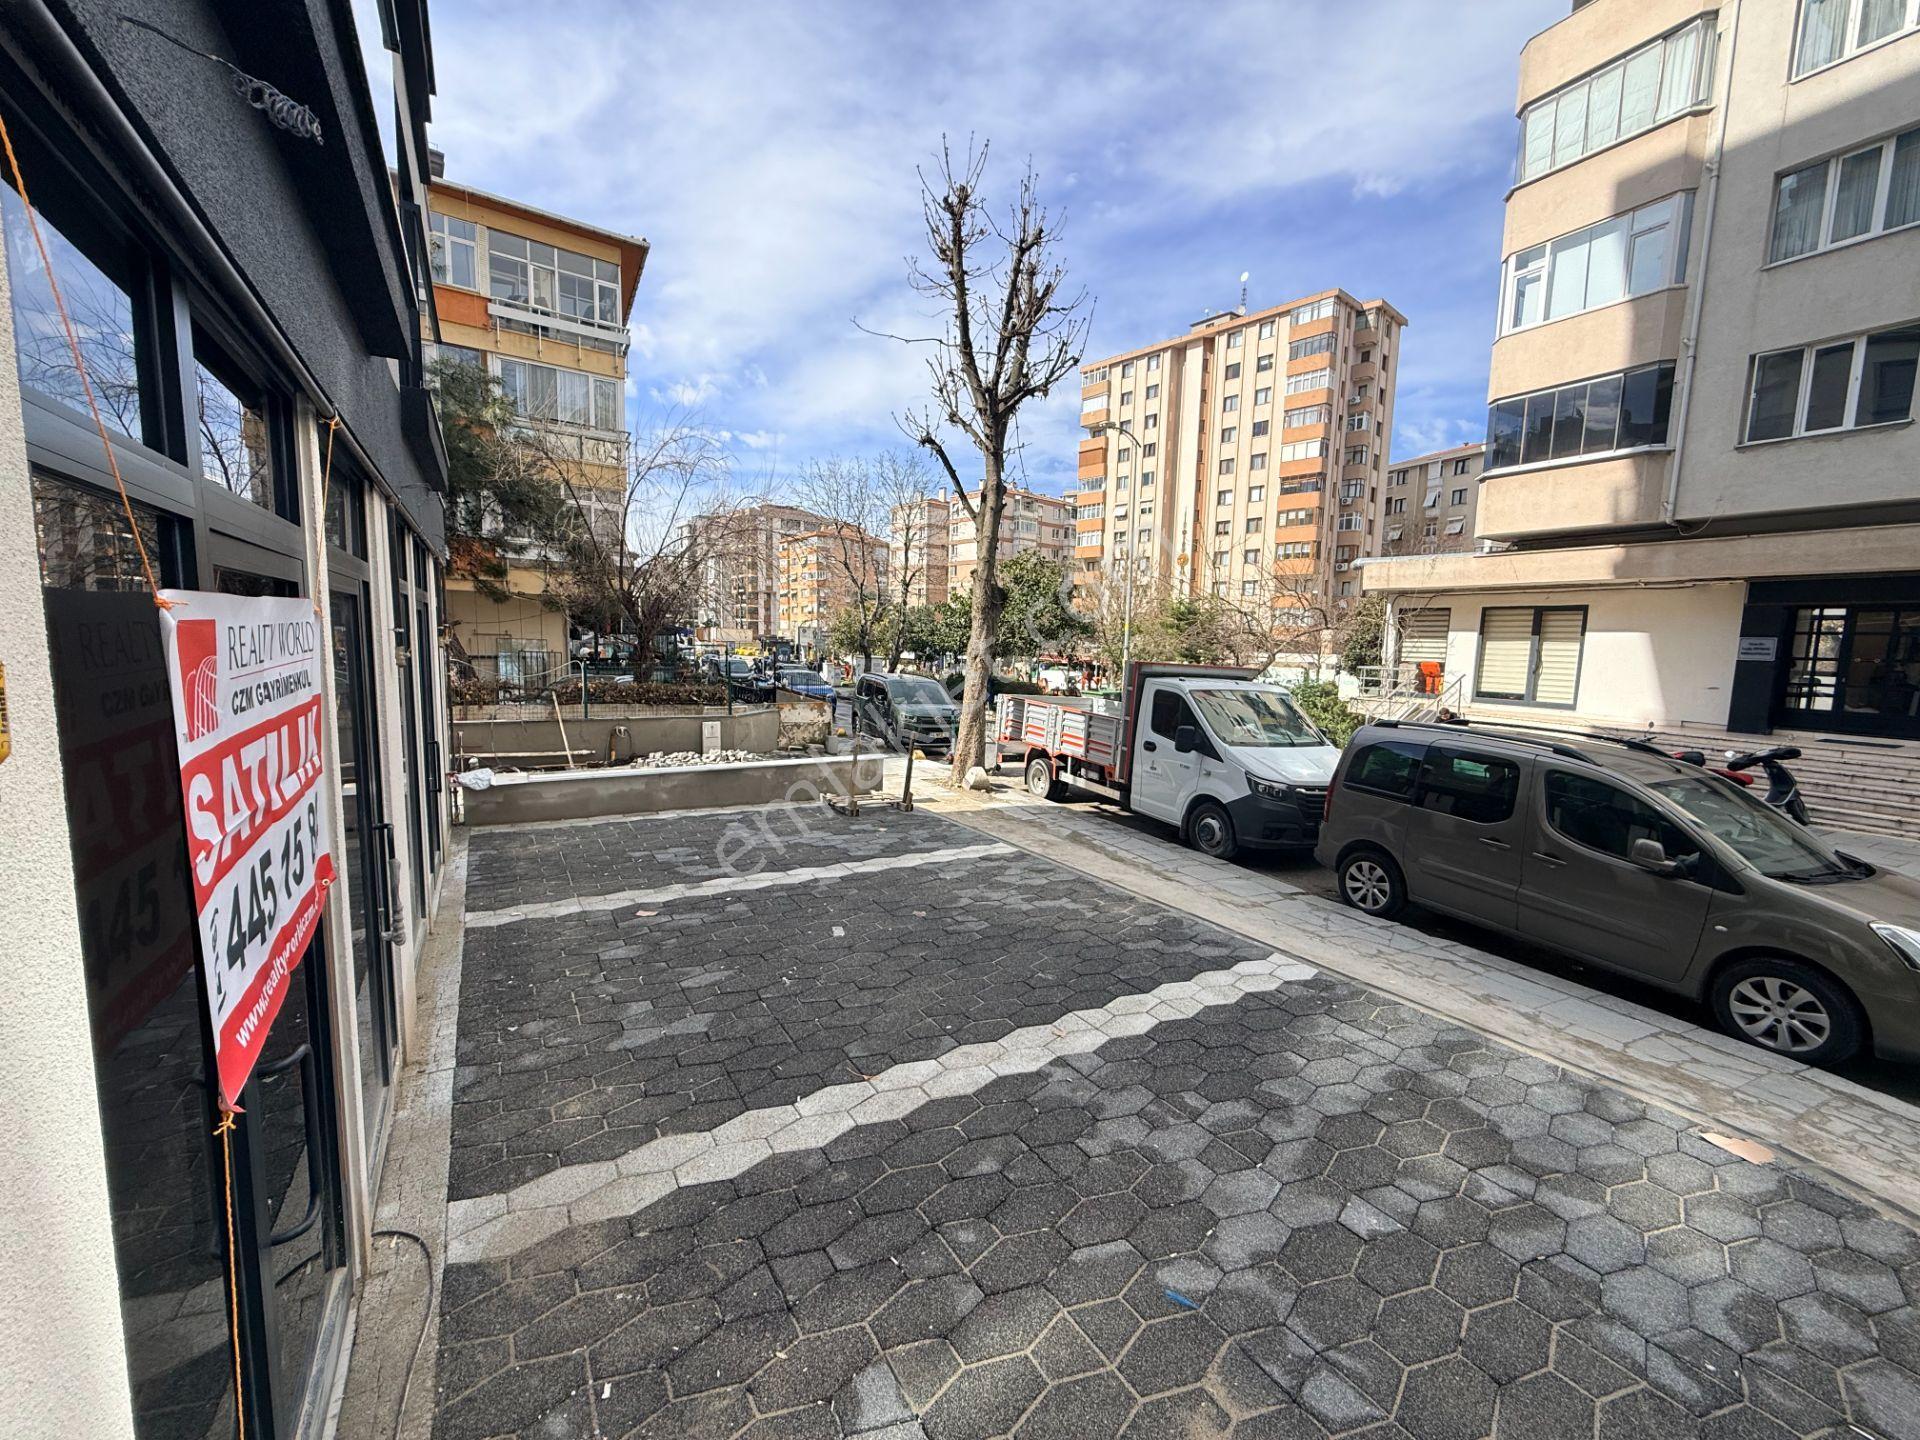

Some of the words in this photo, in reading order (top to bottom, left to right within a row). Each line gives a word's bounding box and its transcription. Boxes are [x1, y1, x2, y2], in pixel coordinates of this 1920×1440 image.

[227, 623, 275, 670] REALTY
[278, 620, 315, 657] WORLD
[231, 689, 255, 716] CZM
[256, 669, 312, 706] GAYRİMENKUL
[188, 705, 321, 887] SATILIK
[227, 849, 278, 972] 445
[281, 816, 305, 900] 15
